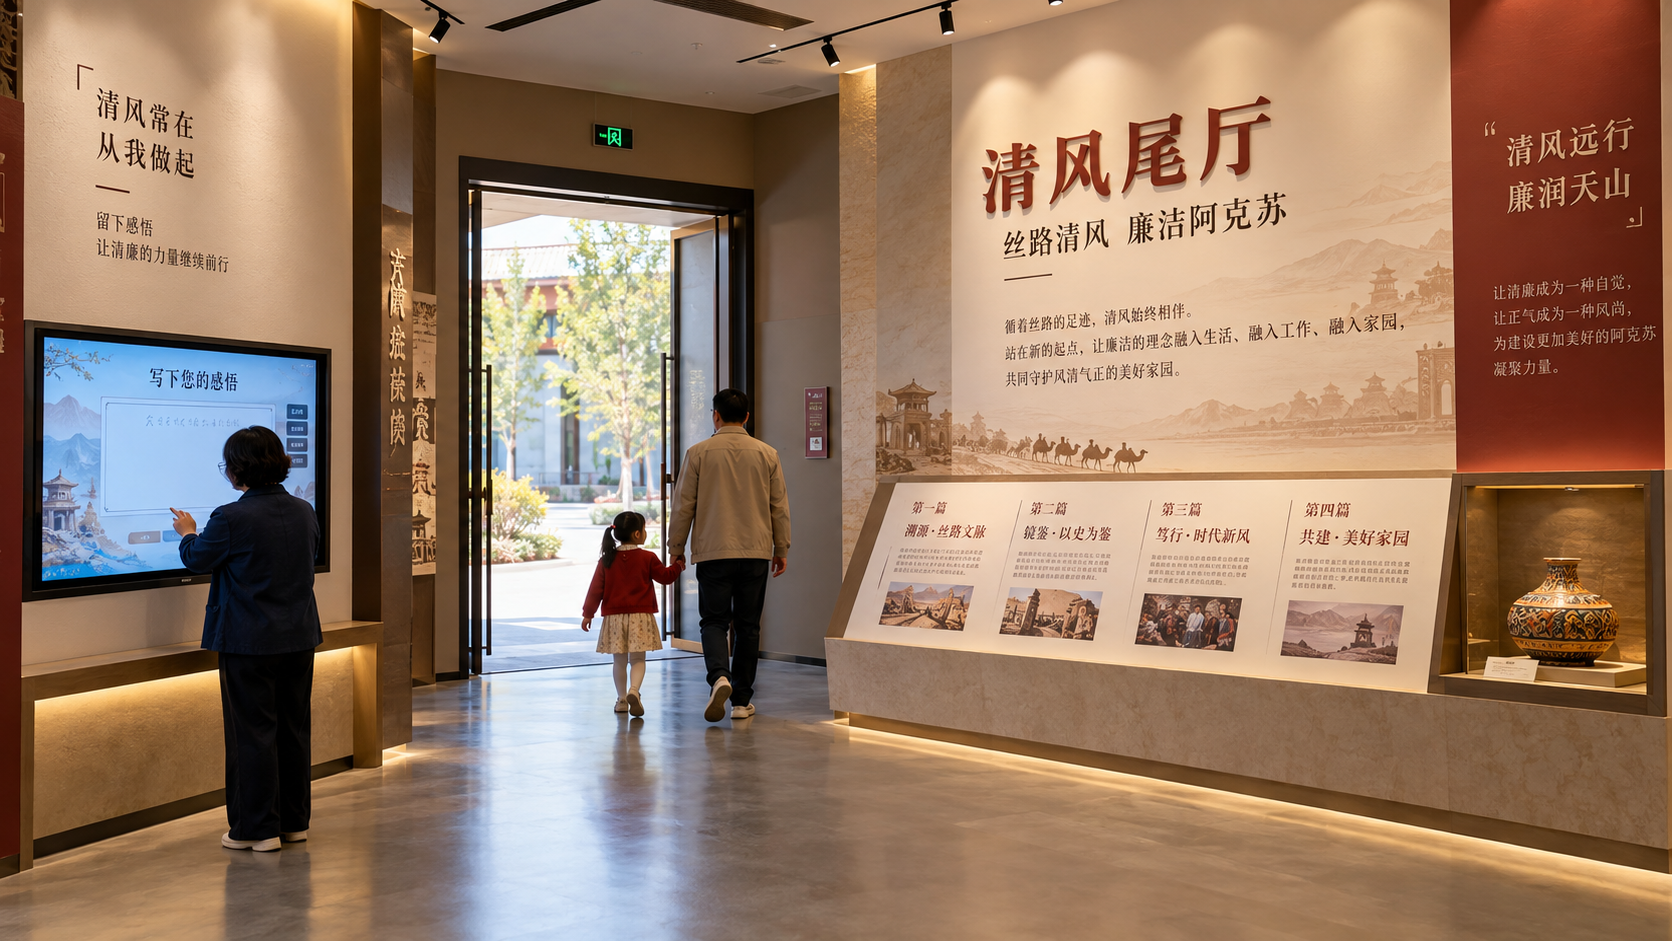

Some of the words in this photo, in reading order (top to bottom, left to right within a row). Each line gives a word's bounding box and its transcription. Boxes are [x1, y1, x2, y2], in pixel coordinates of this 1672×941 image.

[96, 87, 194, 140] 清风常在
[96, 131, 195, 179] 从我做起
[981, 95, 1272, 214] 清风尾厅
[1507, 117, 1635, 168] 清风远行
[1507, 167, 1631, 214] 廉润天山
[96, 211, 153, 237] 留下感悟
[1003, 218, 1109, 260] 丝路清风
[1127, 192, 1287, 246] 廉洁阿克苏
[96, 237, 229, 273] 让清廉的力量继续前行
[1493, 324, 1657, 352] 为建设更加美好的阿克苏
[149, 367, 238, 392] 写下您的感悟
[911, 501, 948, 515] 第一篇
[1029, 501, 1068, 516] 第二篇
[1160, 502, 1203, 517] 第三篇
[1303, 502, 1351, 518] 第四篇
[1298, 528, 1410, 547] 共建·美好家园
